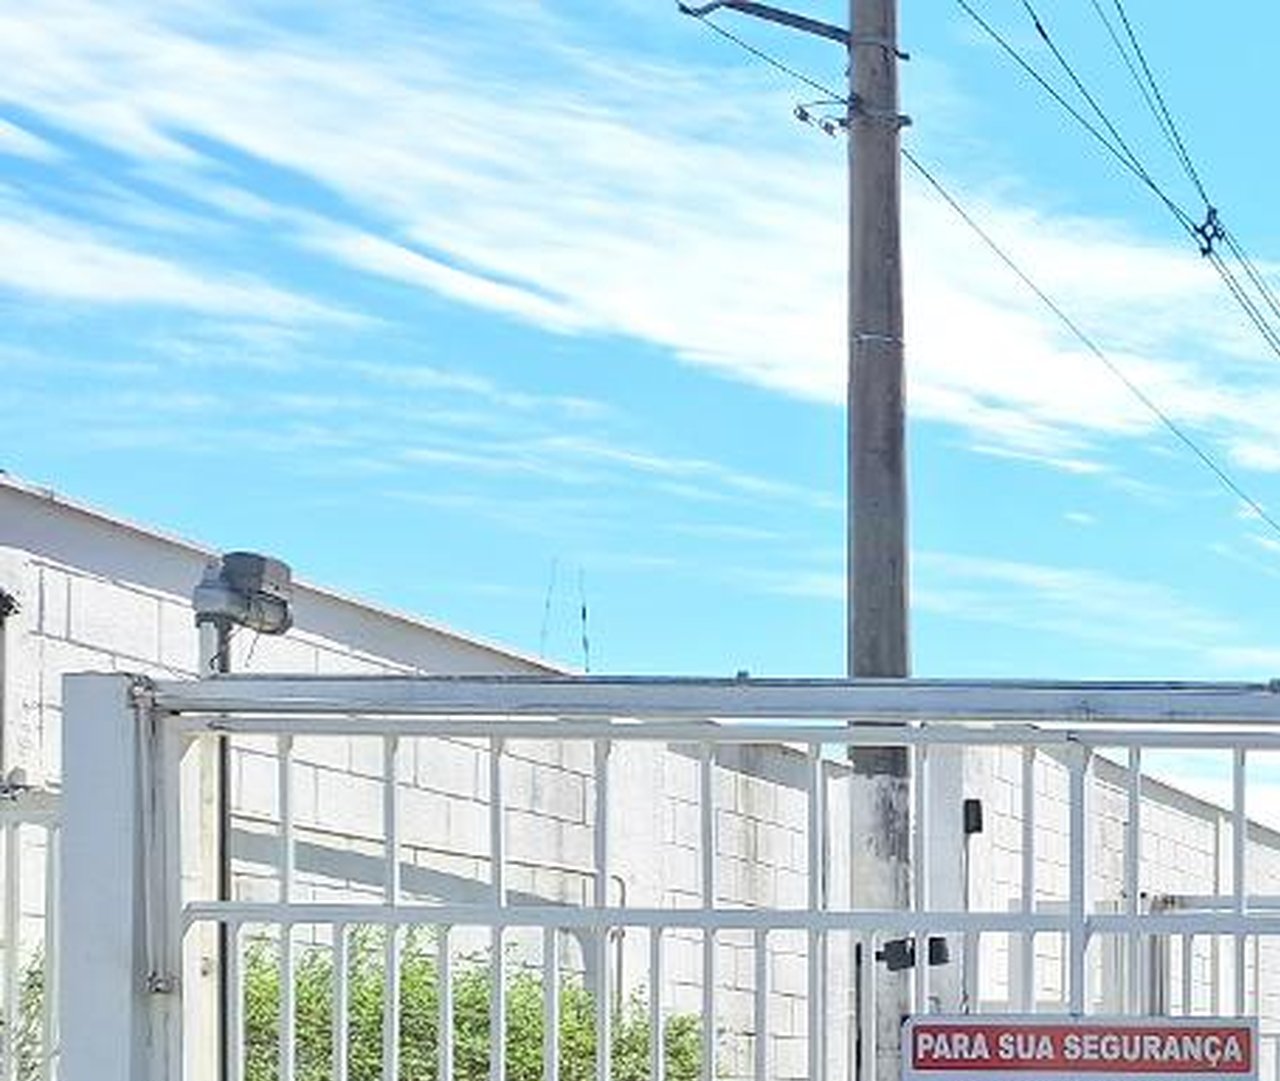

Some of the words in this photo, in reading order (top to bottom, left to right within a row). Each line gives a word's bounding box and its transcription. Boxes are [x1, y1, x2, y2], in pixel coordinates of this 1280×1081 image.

[917, 1032, 989, 1060] PARA
[999, 1033, 1054, 1060] SUA
[1064, 1034, 1243, 1067] SEGURANÇA
